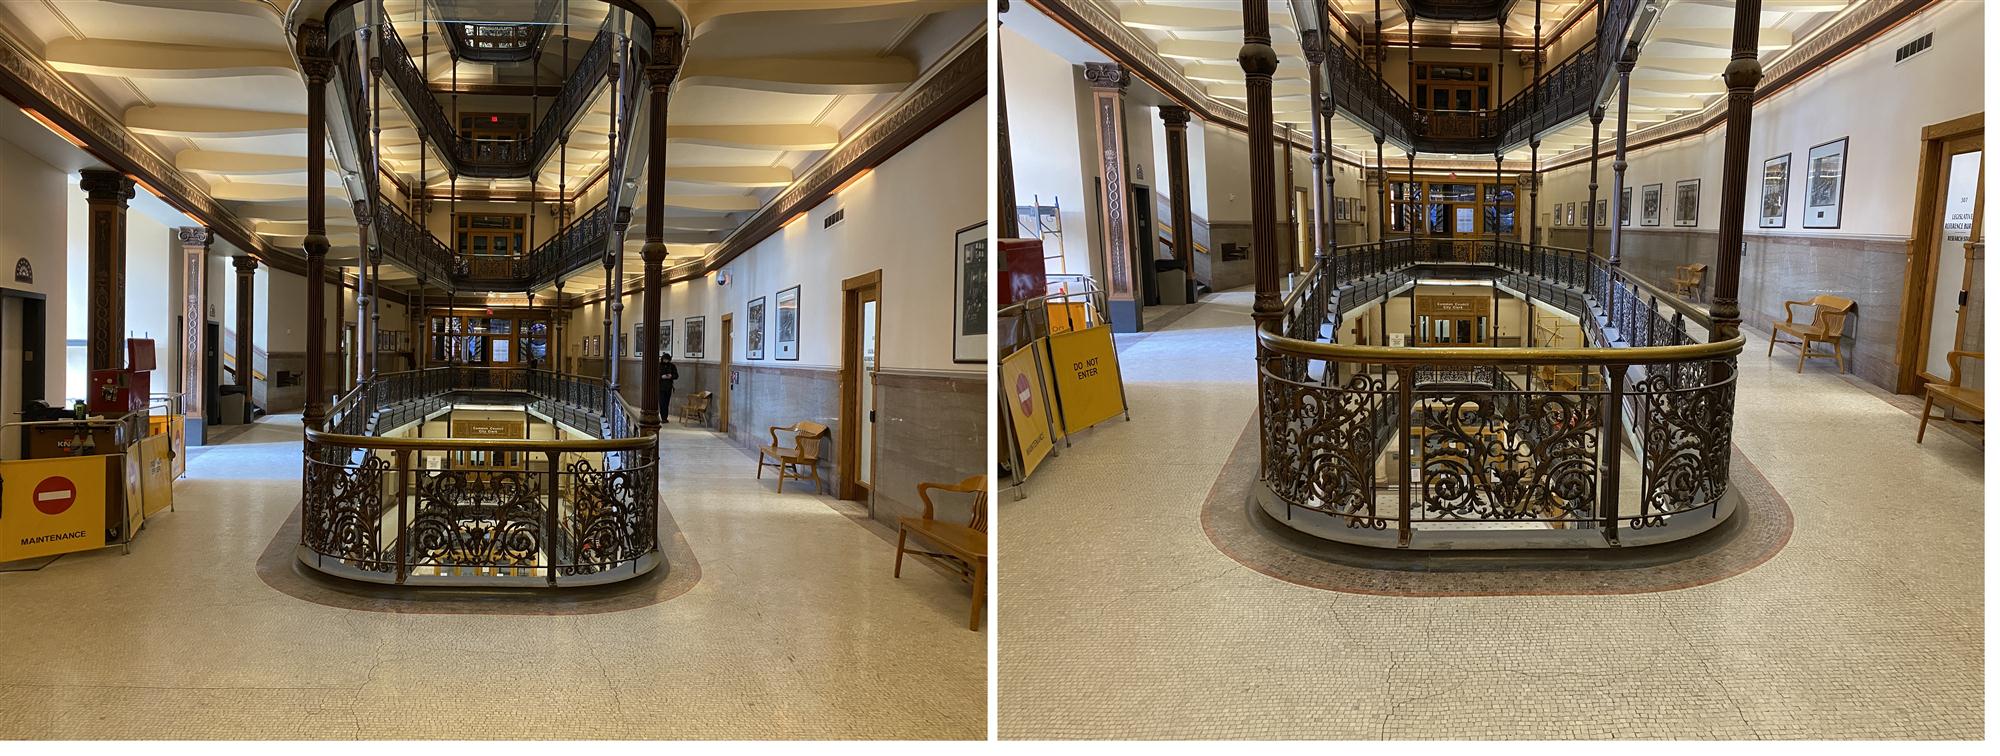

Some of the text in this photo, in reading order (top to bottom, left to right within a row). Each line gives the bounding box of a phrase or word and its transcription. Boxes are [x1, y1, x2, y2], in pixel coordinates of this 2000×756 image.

[1073, 357, 1098, 371] DO NOT
[1077, 367, 1098, 380] ENTER
[21, 530, 87, 546] MAINTENANCE
